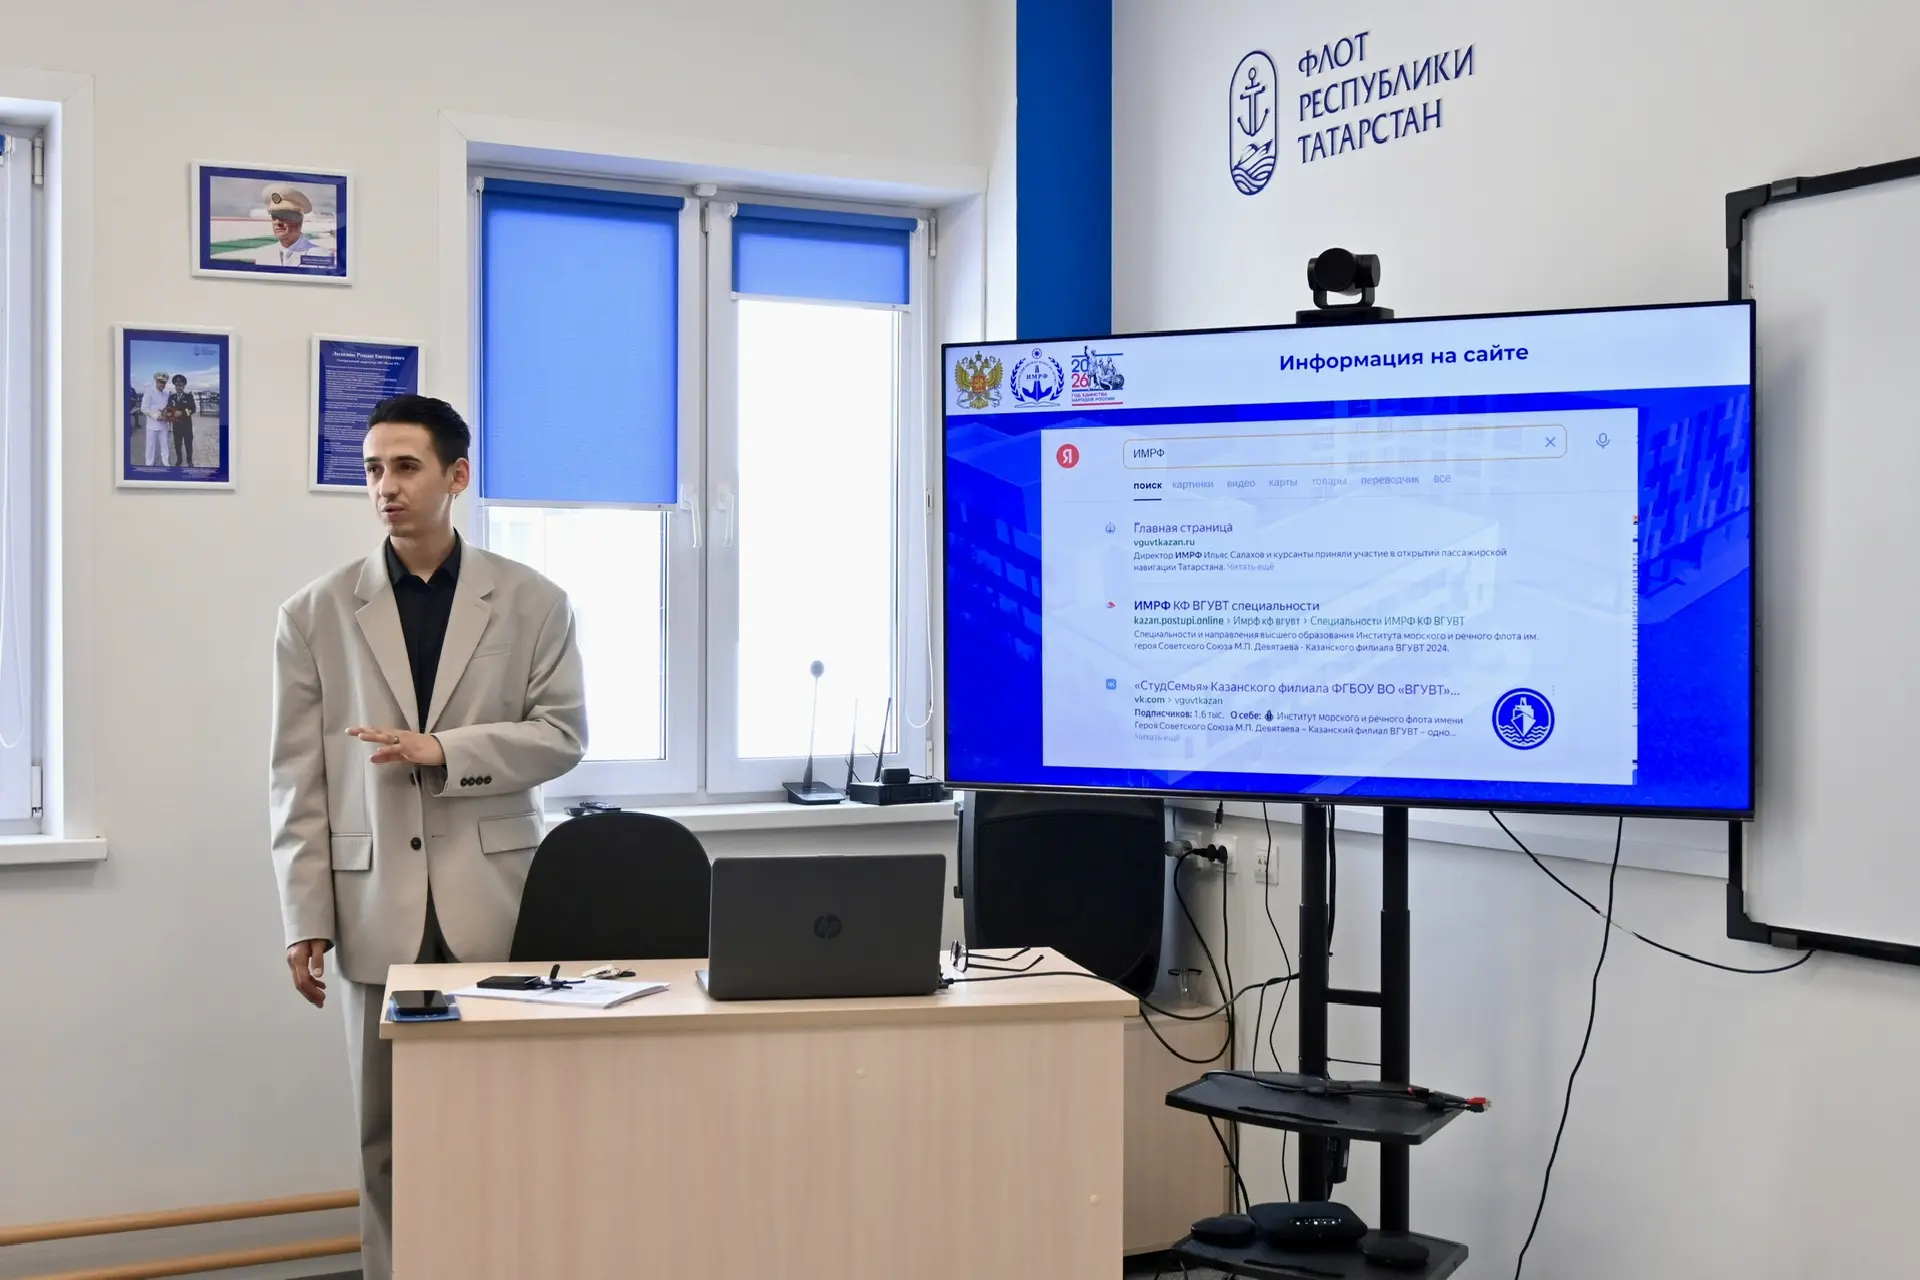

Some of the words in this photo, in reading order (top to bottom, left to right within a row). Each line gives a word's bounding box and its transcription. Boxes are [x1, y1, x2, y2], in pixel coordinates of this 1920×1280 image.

[1298, 30, 1369, 78] ФЛОТ
[1299, 44, 1475, 122] РЕСПУБЛИКИ
[1297, 98, 1443, 164] ТАТАРСТАН
[1279, 352, 1424, 372] Информация
[1430, 350, 1458, 364] на
[1463, 344, 1529, 363] сайте
[1071, 358, 1090, 373] 20
[1071, 373, 1090, 388] 26
[1133, 447, 1165, 459] ИМРФ
[1133, 480, 1163, 491] поиск
[1172, 479, 1214, 490] картинки
[1226, 478, 1256, 489] видео
[1268, 477, 1298, 488] карты
[1311, 476, 1347, 488] товары
[1361, 474, 1420, 486] переводчик
[1134, 522, 1178, 534] Главная
[1180, 522, 1233, 534] страница
[1134, 537, 1195, 547] vguvtkazan.ru
[1134, 551, 1174, 561] Директор
[1175, 551, 1203, 560] ИМРФ
[1204, 551, 1229, 560] Ильяс
[1230, 550, 1265, 560] Салахов
[1273, 551, 1314, 560] курсанты
[1315, 551, 1351, 560] приняли
[1353, 550, 1388, 559] участие
[1398, 550, 1440, 559] открытии
[1441, 549, 1507, 558] пассажирской
[1134, 563, 1176, 571] навигации
[1177, 562, 1226, 571] Татарстана.
[1134, 601, 1171, 611] ИМРФ
[1173, 601, 1190, 611] КФ
[1192, 601, 1229, 611] ВГУВТ
[1231, 601, 1320, 613] специальности
[1134, 615, 1224, 626] kazan.postupi.online
[1233, 615, 1260, 626] Имрф
[1262, 615, 1274, 626] кф
[1275, 617, 1300, 626] вгувт
[1310, 616, 1382, 627] Специальности
[1384, 616, 1416, 626] ИМРФ
[1418, 616, 1432, 626] КФ
[1434, 616, 1464, 626] ВГУВТ
[1134, 630, 1197, 639] Специальности
[1205, 631, 1259, 639] направления
[1260, 632, 1297, 640] высшего
[1298, 631, 1354, 640] образования
[1356, 631, 1402, 640] Института
[1403, 633, 1446, 641] морского
[1455, 633, 1492, 641] речного
[1494, 632, 1522, 641] флота
[1134, 643, 1157, 651] героя
[1158, 642, 1206, 650] Советского
[1207, 642, 1233, 650] Союза
[1234, 643, 1253, 651] М.П.
[1254, 643, 1299, 652] Девятаева
[1305, 643, 1354, 652] Казанского
[1356, 643, 1394, 652] филиала
[1395, 643, 1424, 652] ВГУВТ
[1426, 643, 1450, 652] 2024.
[1135, 680, 1209, 692] «СтудСемья»
[1211, 682, 1276, 693] Казанского
[1278, 682, 1329, 694] филиала
[1331, 682, 1374, 694] ФГБОУ
[1377, 683, 1395, 695] ВО
[1174, 697, 1223, 705] vguvtkazan
[1134, 709, 1192, 718] Подписчиков:
[1239, 711, 1261, 719] себе:
[1277, 712, 1316, 722] Институт
[1318, 714, 1360, 723] морского
[1368, 714, 1404, 724] речного
[1406, 714, 1433, 725] флота
[1134, 722, 1158, 730] Героя
[1159, 722, 1206, 731] Советского
[1207, 723, 1234, 732] Союза
[1235, 724, 1254, 732] М.П.
[1255, 724, 1300, 733] Девятаева
[1308, 725, 1354, 735] Казанский
[1356, 726, 1388, 735] филиал
[1390, 727, 1419, 736] ВГУВТ
